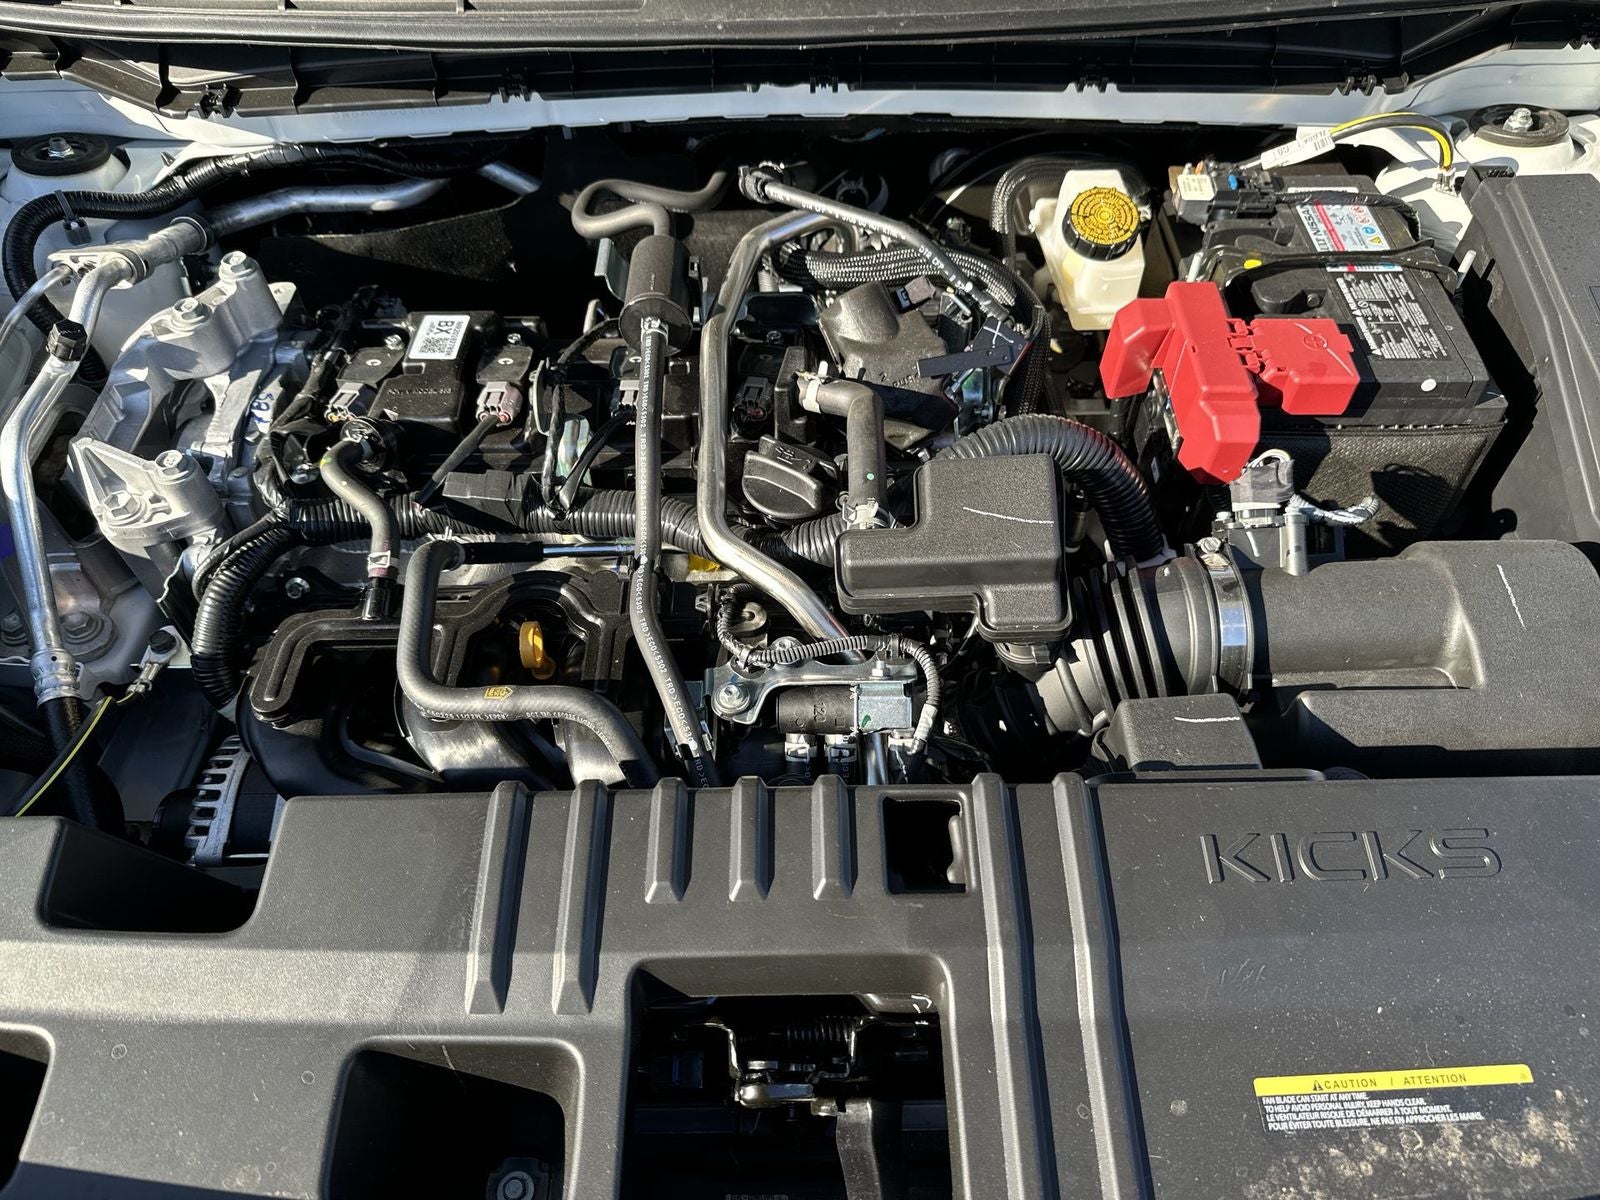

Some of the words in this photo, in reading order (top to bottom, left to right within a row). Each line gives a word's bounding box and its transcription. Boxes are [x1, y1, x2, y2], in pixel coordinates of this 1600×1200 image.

[1200, 828, 1502, 884] KICKS
[1324, 1078, 1377, 1090] CAUTION
[1404, 1073, 1467, 1085] ATTENTION
[1262, 1096, 1275, 1104] FAN
[1275, 1095, 1296, 1104] BLADE
[1296, 1094, 1310, 1103] CAN
[1310, 1093, 1329, 1102] START
[1330, 1093, 1338, 1101] AT
[1338, 1092, 1352, 1101] ANY
[1351, 1091, 1369, 1100] TIME.
[1264, 1105, 1274, 1113] TO
[1274, 1104, 1290, 1113] HELP
[1291, 1103, 1310, 1112] AVOID
[1310, 1101, 1343, 1111] PERSONAL
[1343, 1100, 1366, 1110] INJURY,
[1366, 1099, 1381, 1108] KEEP
[1381, 1098, 1404, 1107] HANDS
[1404, 1097, 1427, 1106] CLEAR.
[1266, 1113, 1275, 1122] LE
[1275, 1111, 1320, 1121] VENTILATEUR
[1320, 1109, 1345, 1119] RISQUE
[1346, 1109, 1356, 1118] DE
[1356, 1106, 1393, 1117] DÉMARRER
[1394, 1105, 1400, 1115] À
[1400, 1105, 1419, 1114] TOUT
[1419, 1104, 1452, 1113] MOMENT.
[1268, 1121, 1288, 1131] POUR
[1288, 1120, 1312, 1130] ÉVITER
[1312, 1118, 1335, 1129] TOUTE
[1335, 1117, 1370, 1127] BLESSURE,
[1370, 1116, 1381, 1126] NE
[1381, 1115, 1395, 1125] PAS
[1394, 1115, 1405, 1125] EN
[1405, 1112, 1447, 1123] APPROCHER
[1446, 1112, 1459, 1122] LES
[1459, 1111, 1485, 1121] MAINS.
